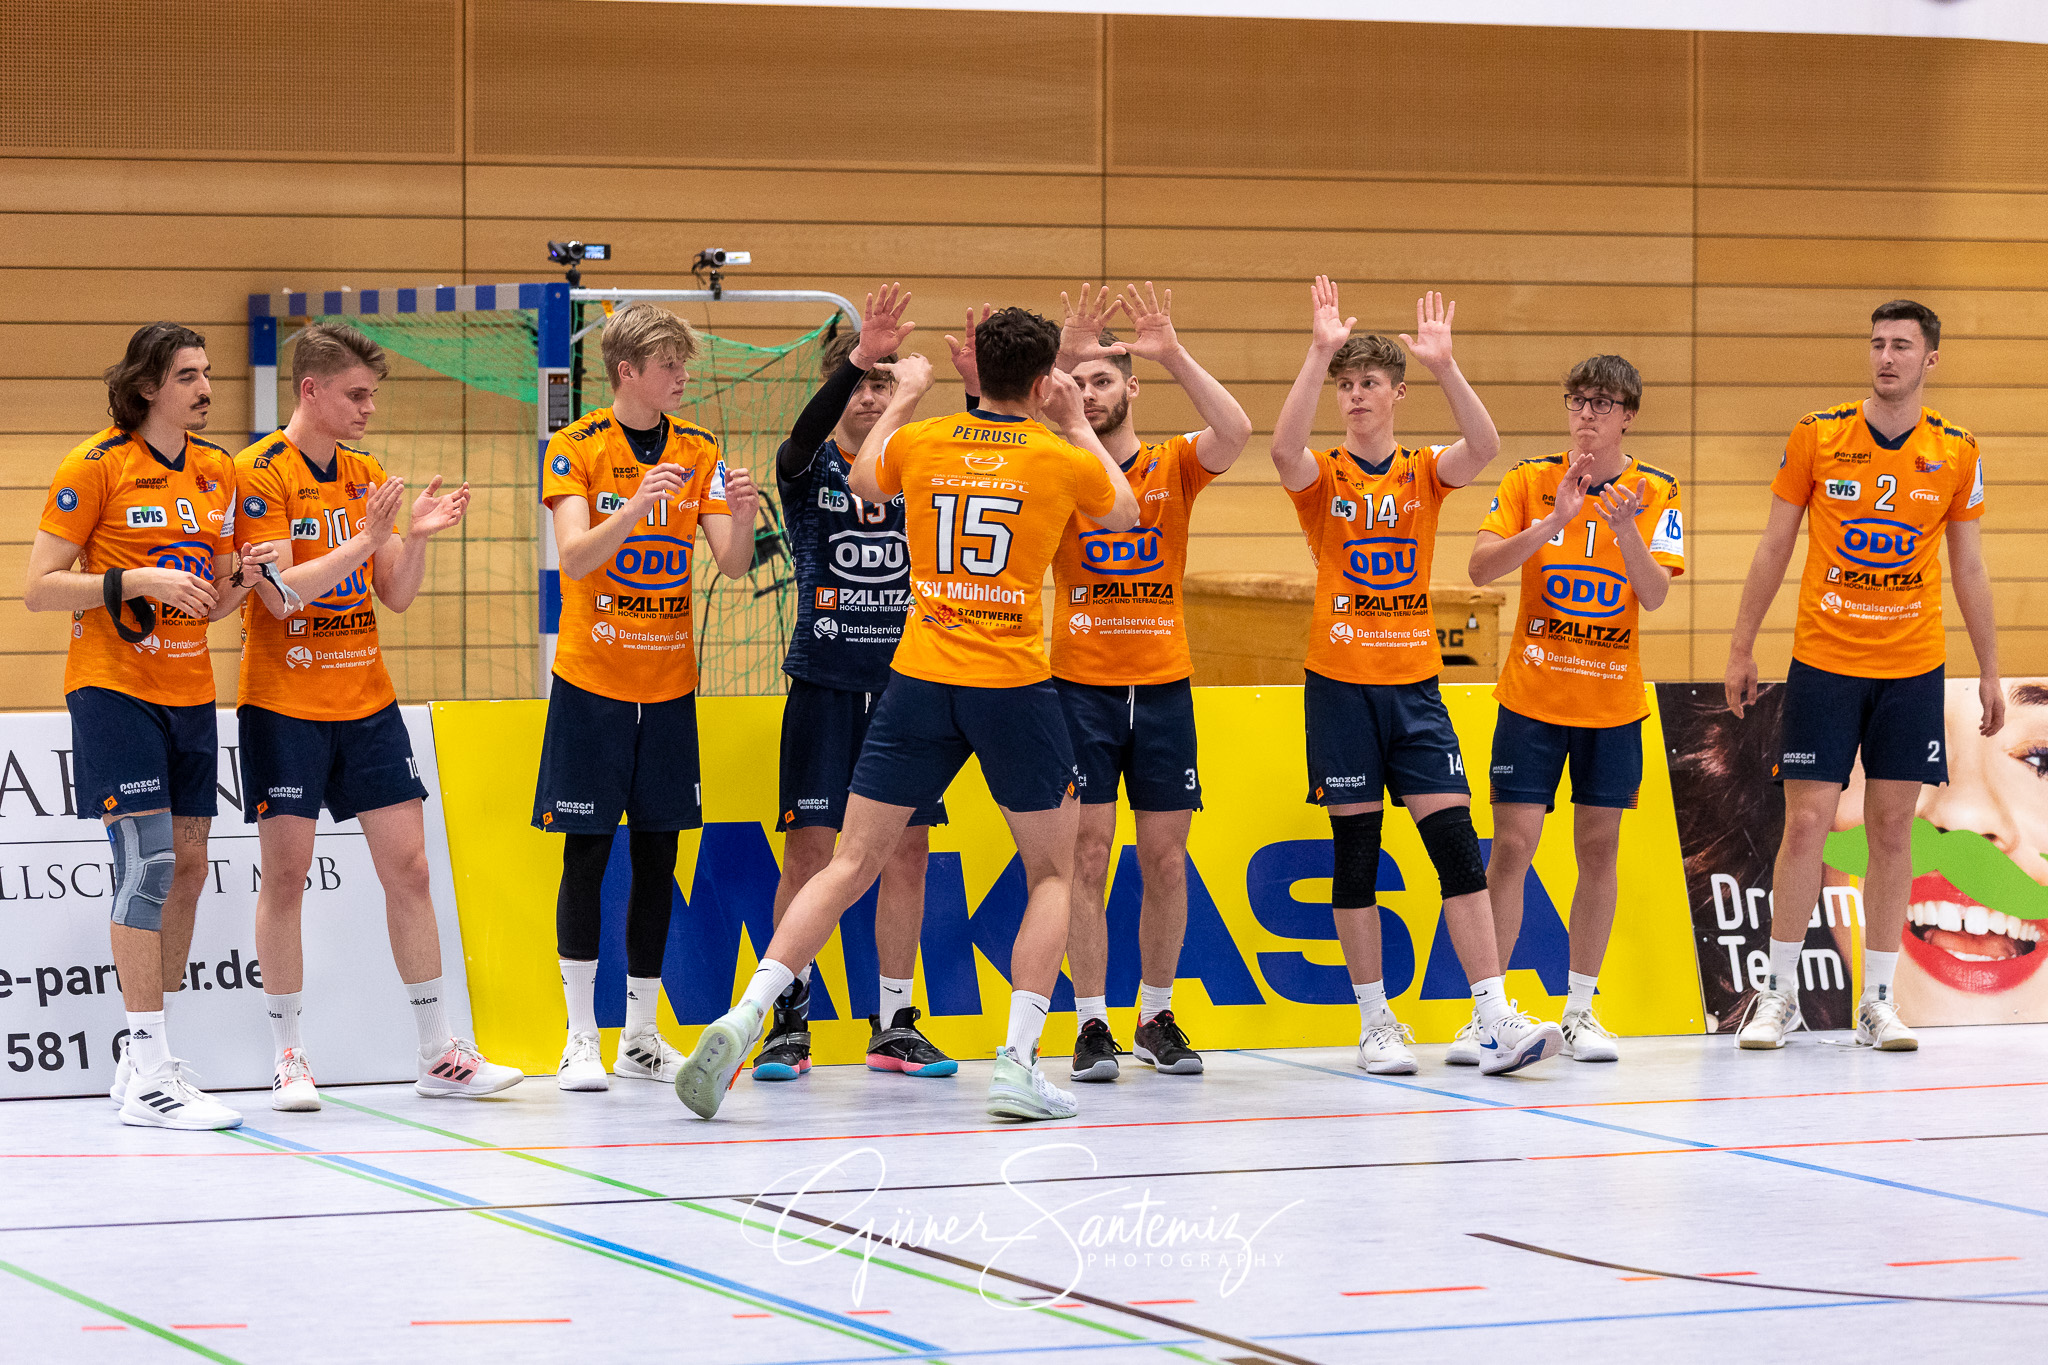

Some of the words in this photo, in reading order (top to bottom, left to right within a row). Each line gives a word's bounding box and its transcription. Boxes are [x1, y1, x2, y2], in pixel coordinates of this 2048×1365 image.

[952, 425, 1028, 445] PETRUSIC
[931, 478, 1029, 494] SCHEIDL
[1829, 483, 1856, 497] EVIS
[1874, 473, 1898, 512] 2
[1147, 490, 1170, 501] max
[1914, 492, 1940, 502] max
[132, 511, 163, 524] EVIS
[175, 498, 201, 534] 9
[1363, 493, 1399, 530] 14
[323, 507, 352, 548] 10
[932, 493, 1024, 578] 15
[1585, 520, 1597, 558] 1
[1844, 527, 1917, 556] ODU
[835, 542, 904, 569] ODU
[1085, 536, 1158, 563] ODU
[615, 548, 687, 576] ODU
[1350, 547, 1416, 576] ODU
[1844, 570, 1923, 587] PALITZA
[916, 581, 942, 598] TSV
[947, 581, 1025, 605] Mühldorf
[1092, 582, 1174, 599] PALITZA
[1546, 574, 1621, 607] ODU
[1355, 593, 1428, 611] PALITZA
[1844, 600, 1905, 613] Dentalservice
[618, 610, 639, 619] HOCH
[957, 607, 1023, 622] STADTWERKE
[1094, 616, 1156, 626] Dentalservice
[1157, 617, 1175, 627] Gust
[619, 629, 674, 642] Dentalservice
[841, 623, 901, 634] Dentalservice
[1099, 628, 1171, 636] www.dentalservice-gust.de
[1412, 628, 1431, 638] Gust
[1548, 618, 1631, 644] PALITZA
[1548, 633, 1566, 642] HOCH
[1567, 636, 1583, 644] UND
[1584, 639, 1611, 648] TIEFBAU
[315, 648, 367, 660] Dentalservice
[1547, 651, 1607, 669] Dentalservice
[1609, 661, 1628, 672] Gust
[1550, 666, 1624, 680] www.dentalservice-gust.de
[1927, 740, 1940, 763] 2
[1447, 752, 1464, 776] 14
[120, 776, 160, 792] panzeri
[1185, 768, 1196, 790] 3
[1325, 772, 1366, 785] panzeri
[268, 785, 303, 796] panzeri
[556, 800, 594, 810] panzeri
[1710, 873, 1866, 930] Drm
[1717, 935, 1845, 993] Tem
[7, 1030, 89, 1073] 581
